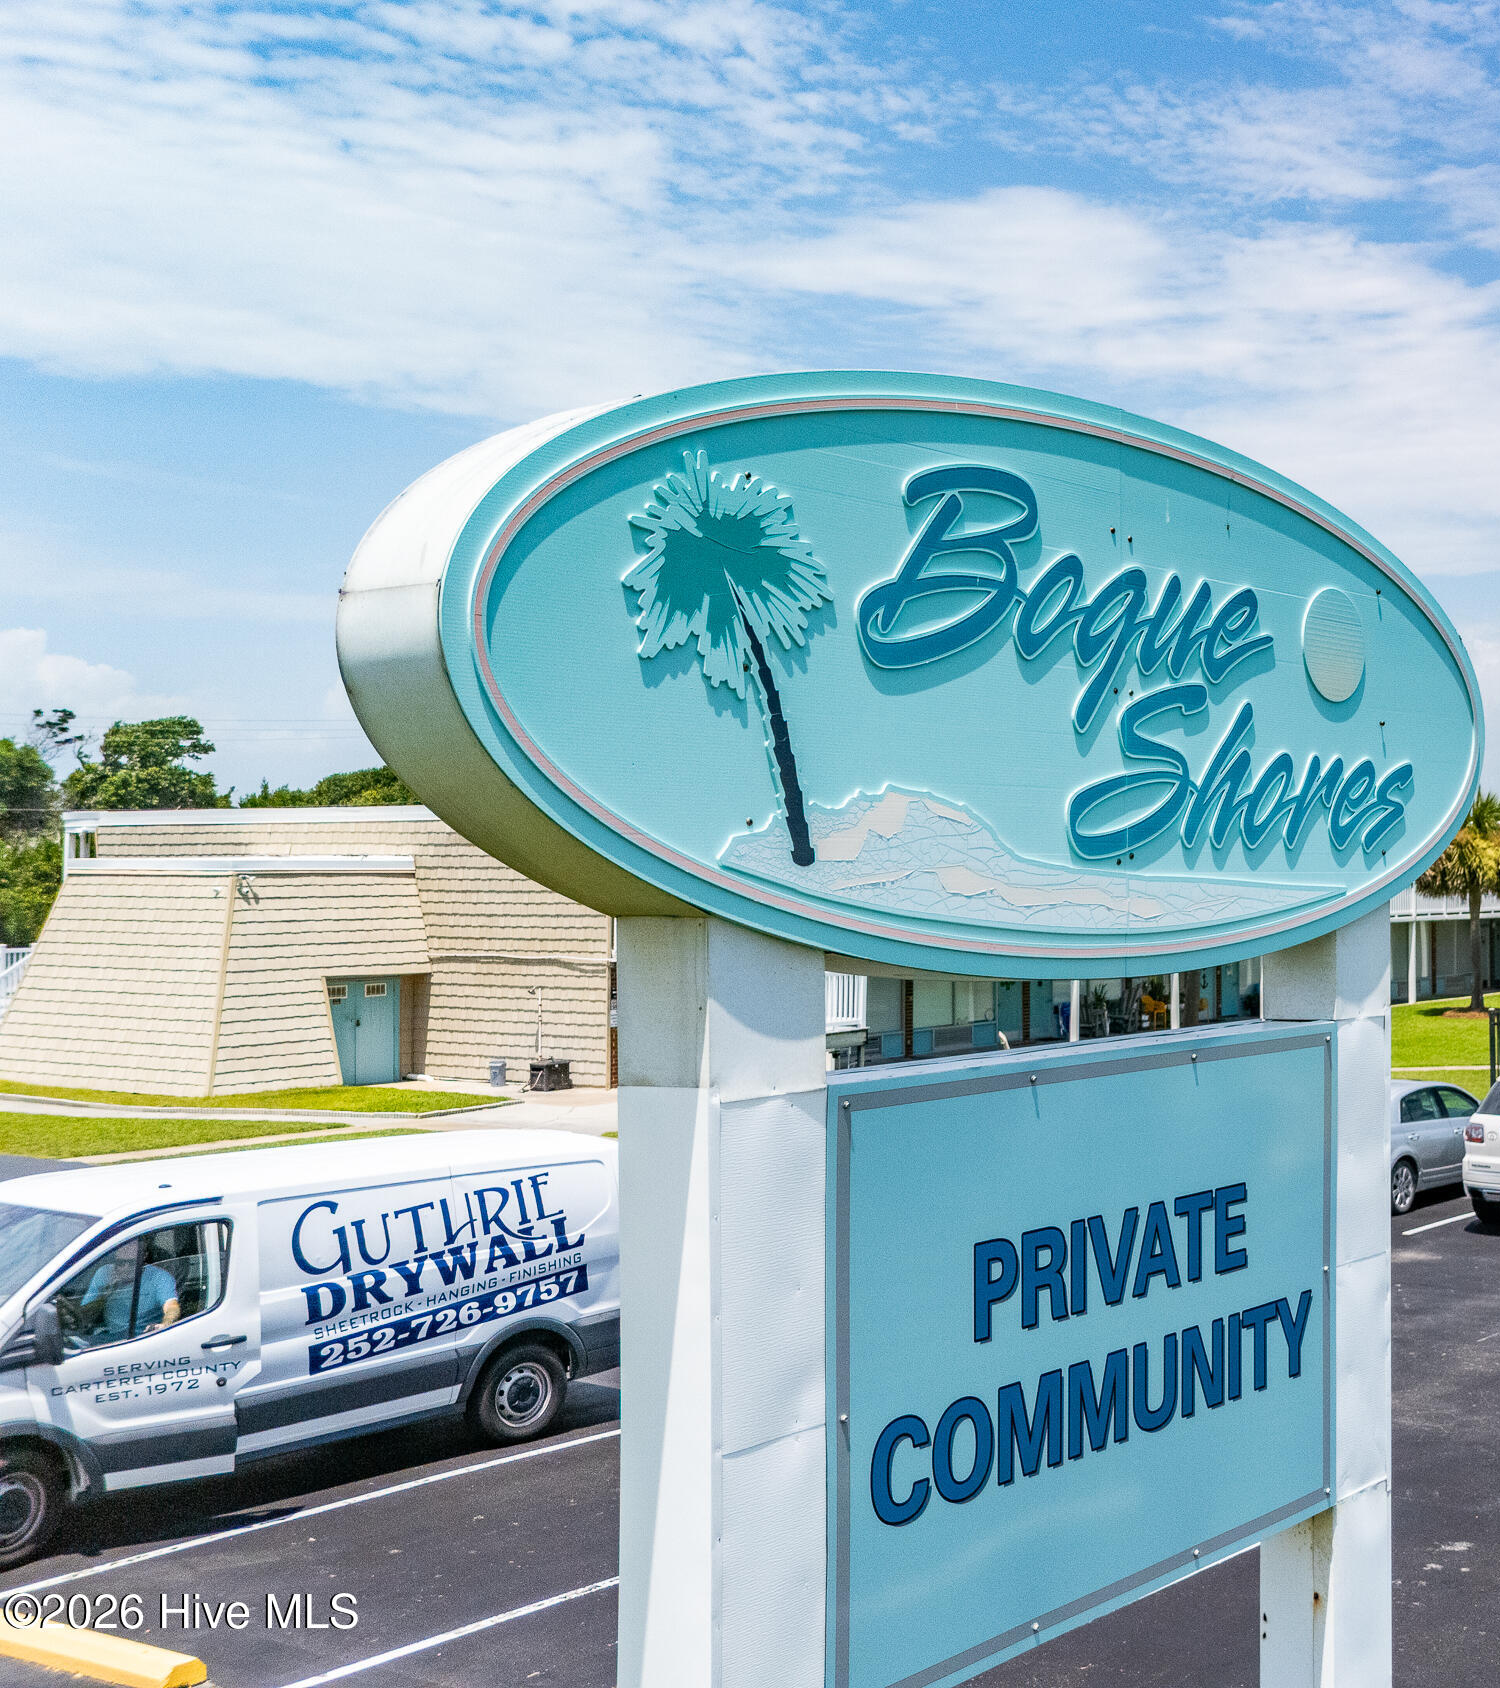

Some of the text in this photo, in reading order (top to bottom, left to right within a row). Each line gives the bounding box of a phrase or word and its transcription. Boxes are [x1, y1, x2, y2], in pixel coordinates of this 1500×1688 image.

[857, 463, 1273, 732] Bogue
[1067, 684, 1414, 859] Shores
[301, 1216, 586, 1326] DRYWALL
[313, 1252, 583, 1340] SHEETROCK HANGING FINISHING
[973, 1182, 1248, 1343] PRIVATE
[103, 1356, 192, 1377] SERVING
[319, 1270, 580, 1369] 252-726-9757
[51, 1360, 242, 1397] CARTERET COUNTY
[95, 1378, 200, 1404] EST. 1972
[870, 1290, 1313, 1527] COMMUNITY
